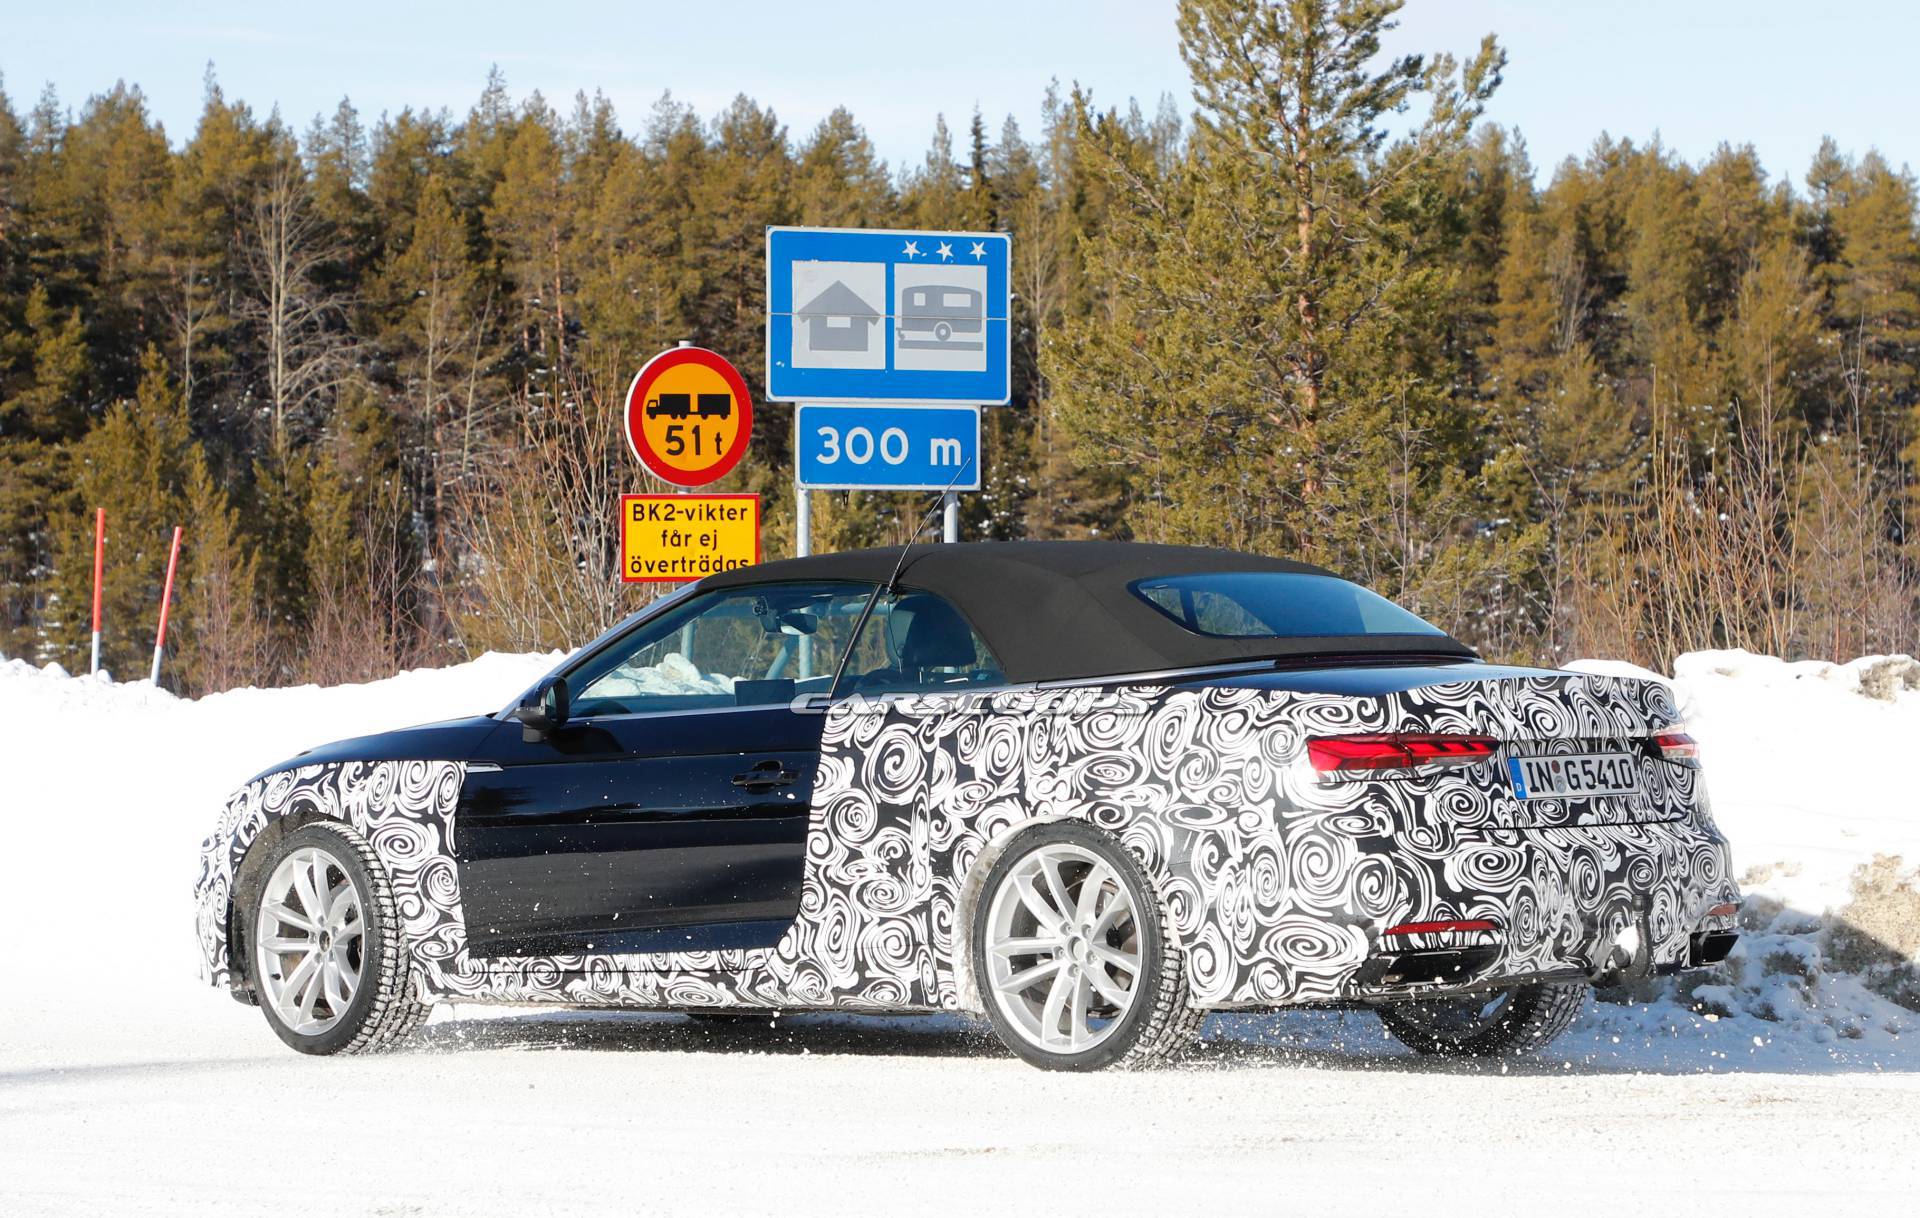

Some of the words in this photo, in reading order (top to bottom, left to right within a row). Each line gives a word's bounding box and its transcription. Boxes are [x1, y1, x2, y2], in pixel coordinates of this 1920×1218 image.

[665, 424, 701, 456] 51
[714, 431, 724, 456] t
[815, 426, 909, 465] 300
[930, 437, 962, 466] m
[633, 503, 748, 521] BK2-vikter
[661, 528, 693, 547] får
[699, 530, 718, 551] ej
[630, 554, 749, 574] överträdas
[1526, 761, 1555, 793] IN
